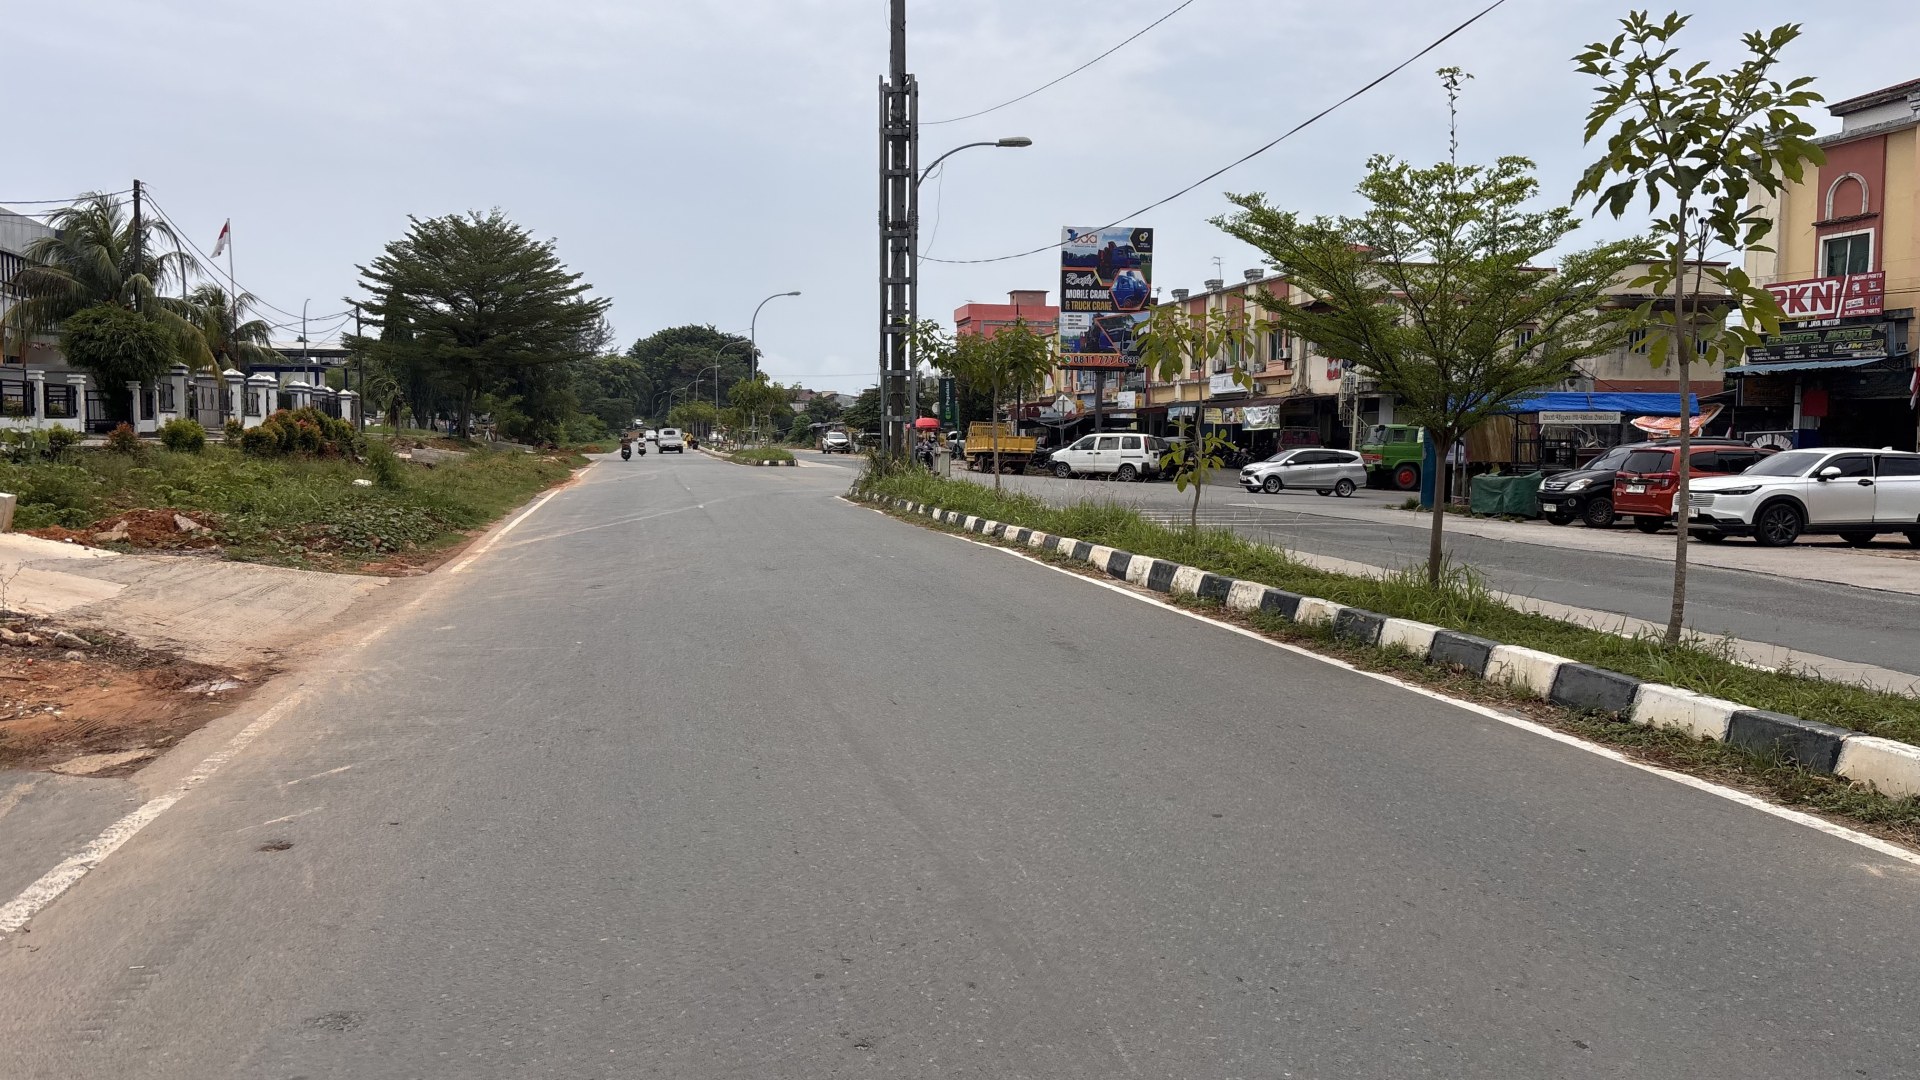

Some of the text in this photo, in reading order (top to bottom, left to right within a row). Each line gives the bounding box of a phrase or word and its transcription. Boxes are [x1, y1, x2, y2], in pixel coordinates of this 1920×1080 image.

[1066, 289, 1110, 300] MOBILE CRANE
[1065, 301, 1113, 311] & TRUCK CRANE
[1824, 328, 1873, 341] MOTOR
[1074, 355, 1095, 364] 0811
[1099, 355, 1115, 364] 777
